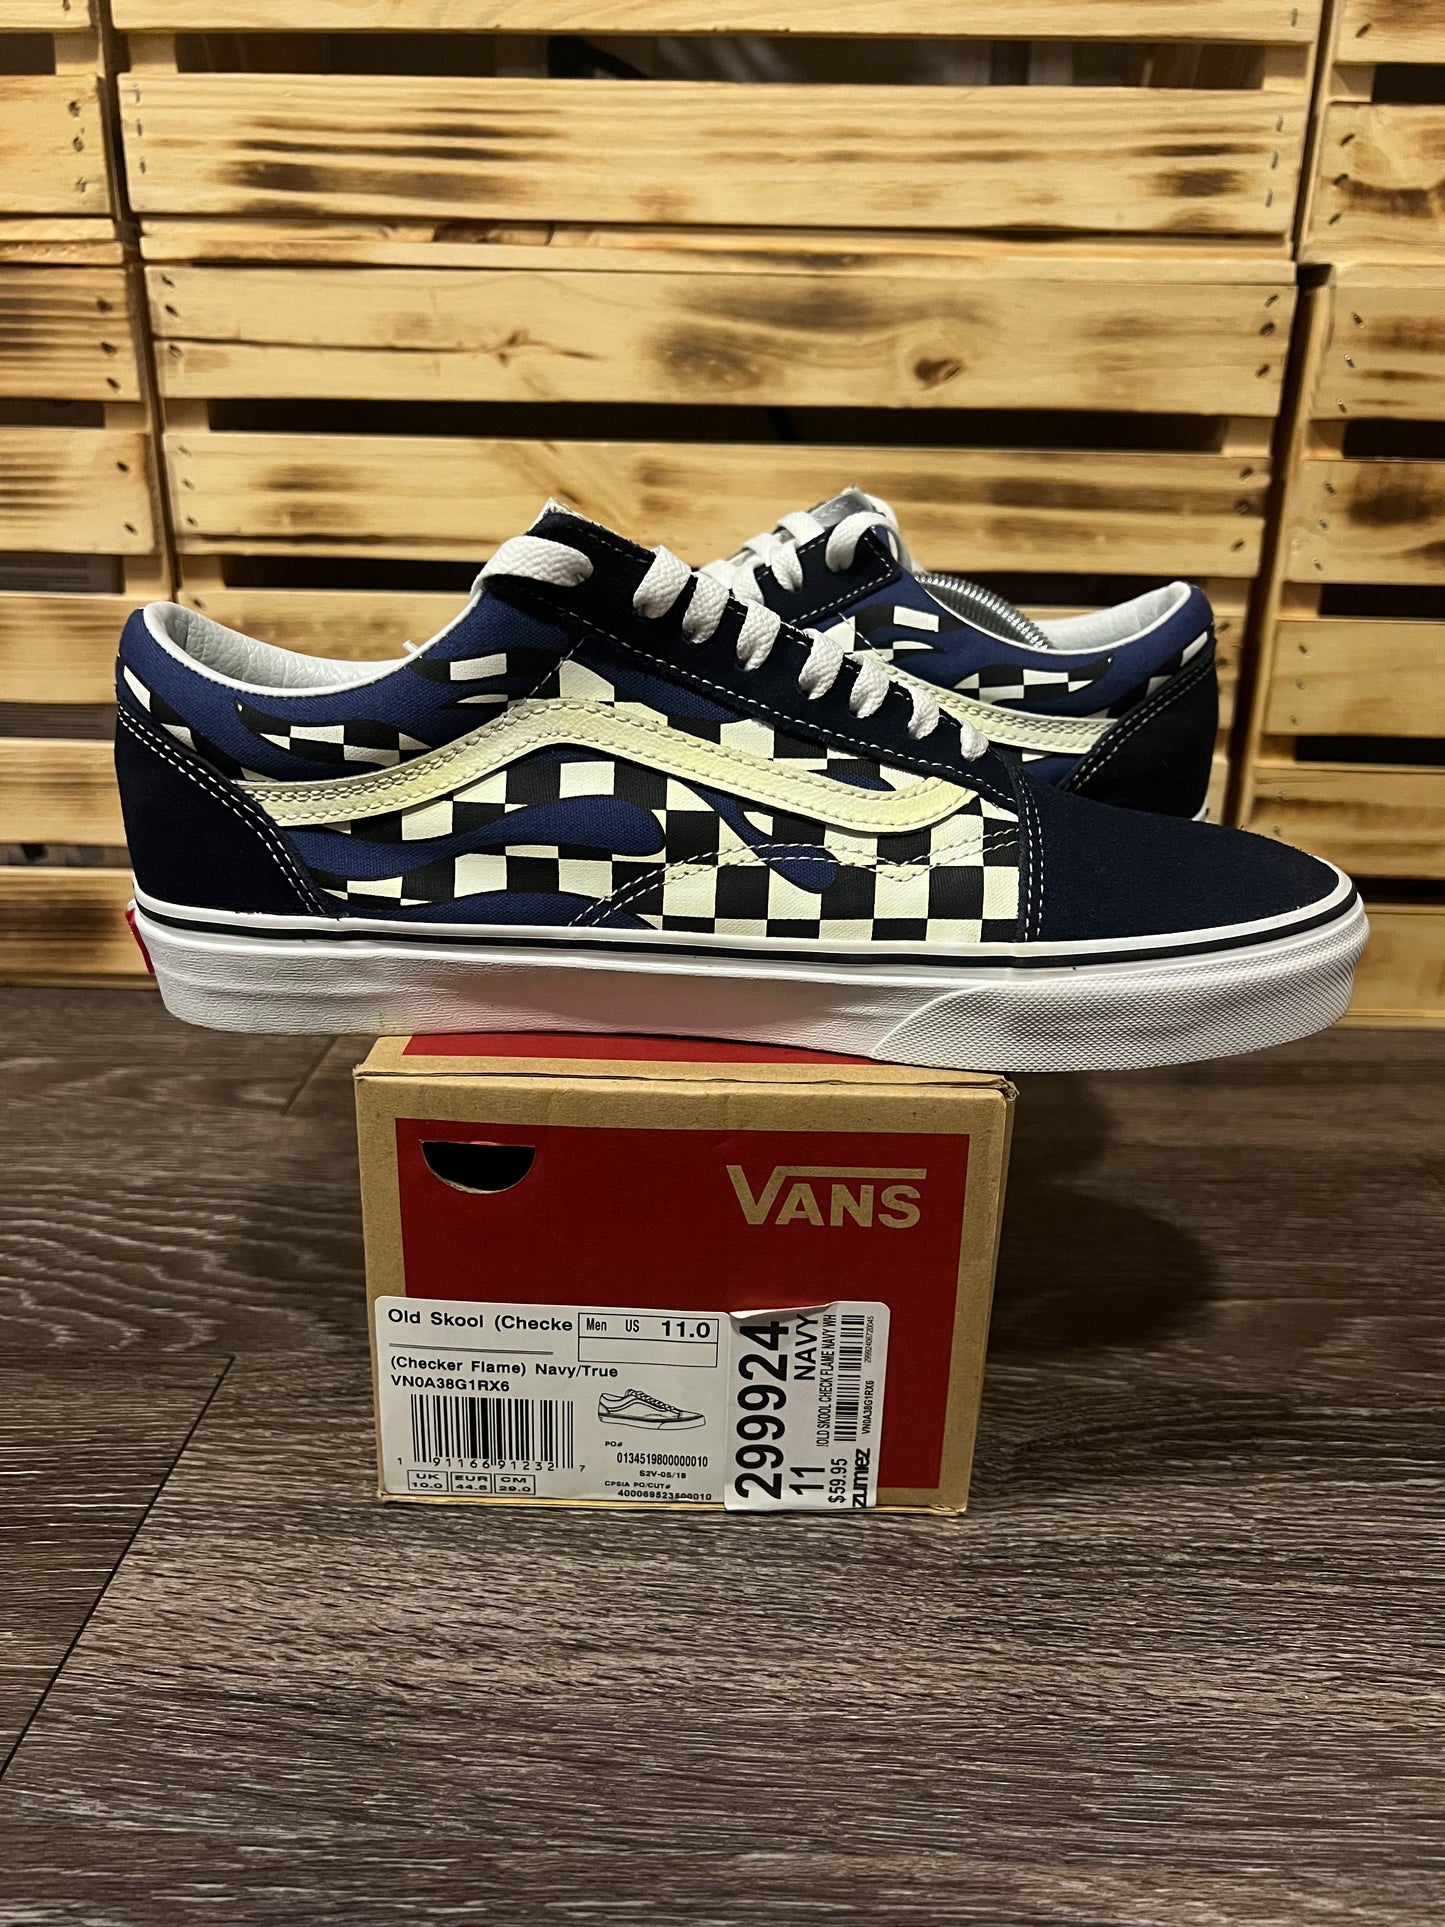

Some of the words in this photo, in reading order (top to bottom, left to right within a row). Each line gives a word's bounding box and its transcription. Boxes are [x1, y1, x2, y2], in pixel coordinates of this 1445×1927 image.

[726, 1165, 927, 1228] VANS
[388, 1309, 421, 1324] Old
[431, 1312, 484, 1328] Skool
[495, 1315, 573, 1331] (Checke
[586, 1318, 607, 1331] Men
[625, 1319, 640, 1332] US
[662, 1320, 711, 1338] 11.0
[794, 1313, 818, 1380] NAVY
[822, 1328, 836, 1349] NAVY
[391, 1356, 463, 1372] (Checker
[471, 1360, 526, 1376] Flame)
[535, 1363, 618, 1378] Navy/True
[821, 1351, 835, 1375] FLAME
[820, 1377, 833, 1402] CHECK
[735, 1321, 789, 1499] 299924
[817, 1404, 831, 1428] SKOOL
[789, 1466, 825, 1495] 11
[828, 1459, 847, 1503] $59.95
[853, 1448, 870, 1507] zumiez
